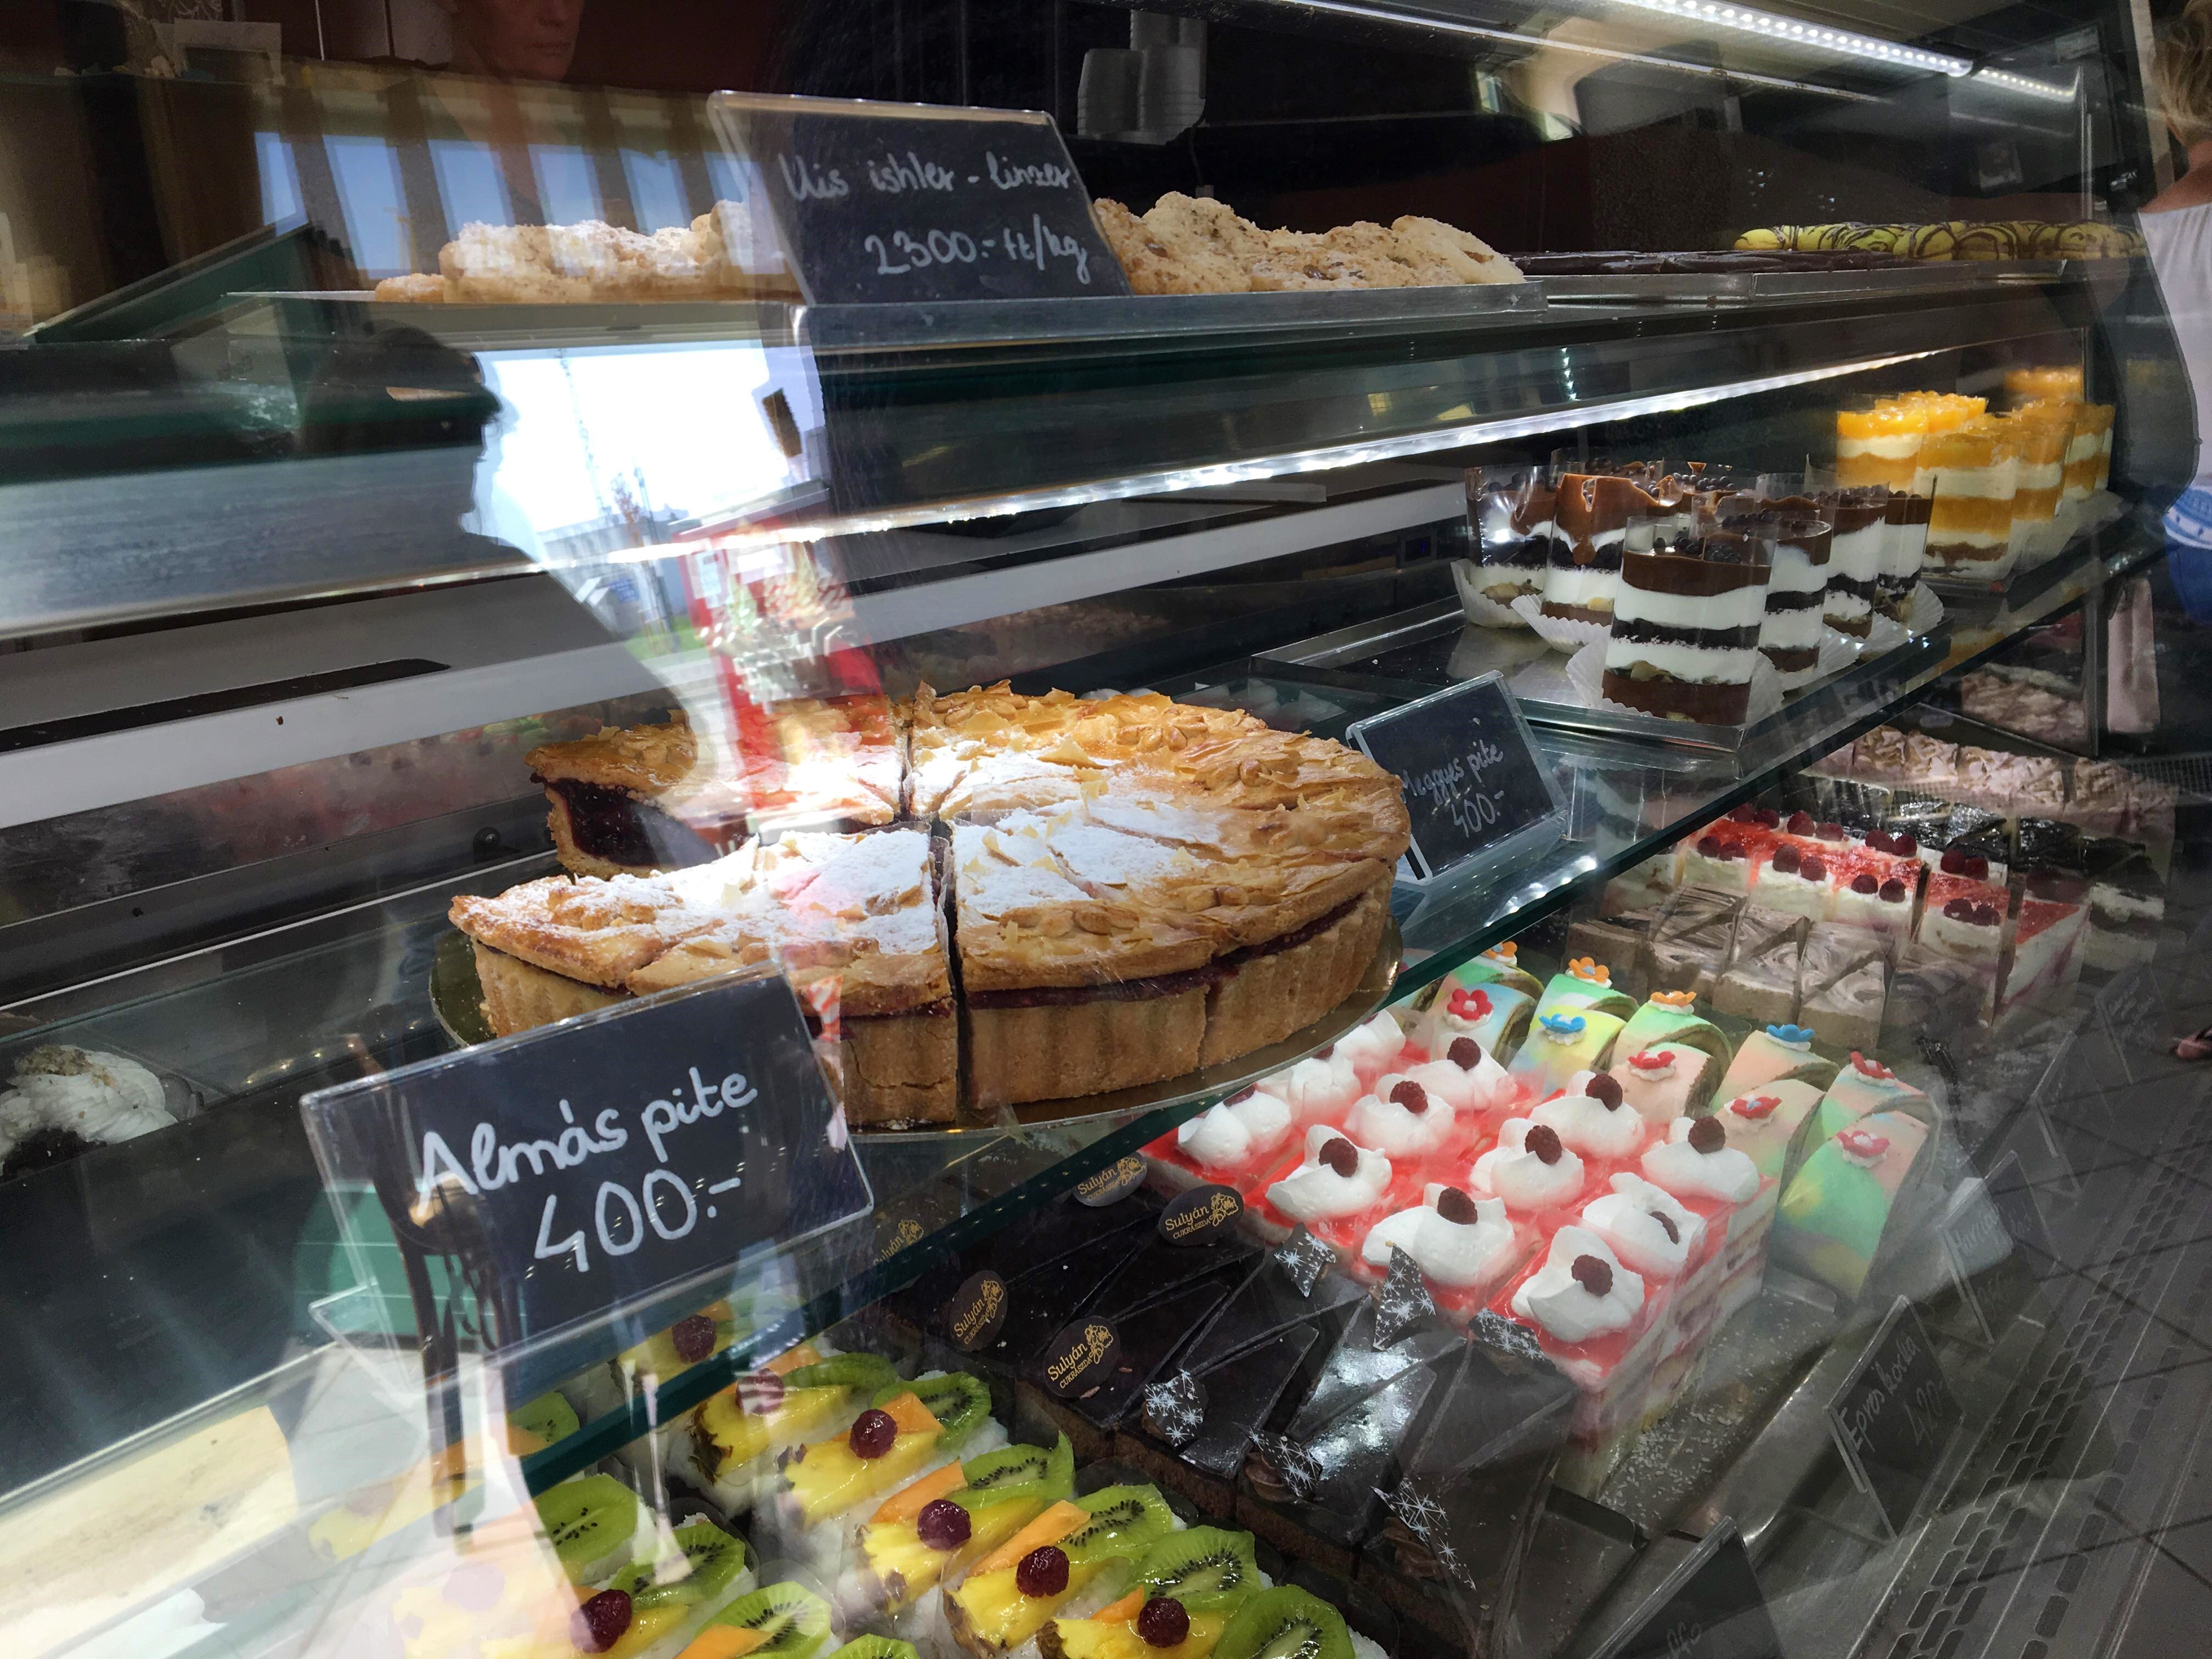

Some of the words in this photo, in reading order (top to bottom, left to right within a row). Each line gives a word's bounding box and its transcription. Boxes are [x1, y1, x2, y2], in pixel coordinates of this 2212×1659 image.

[867, 150, 955, 194] ishler
[1466, 739, 1504, 783] pite
[417, 1099, 628, 1214] Almás
[641, 1066, 758, 1163] pite
[1078, 1169, 1118, 1195] Sulyán
[533, 1169, 741, 1273] 400.-
[1165, 1205, 1210, 1232] Sulyán
[1173, 1218, 1212, 1240] CUKRÁSZDA
[954, 1299, 985, 1338] Sulyán
[1047, 1343, 1088, 1381] Sulyán
[1059, 1357, 1093, 1389] CUKRÁSZDA
